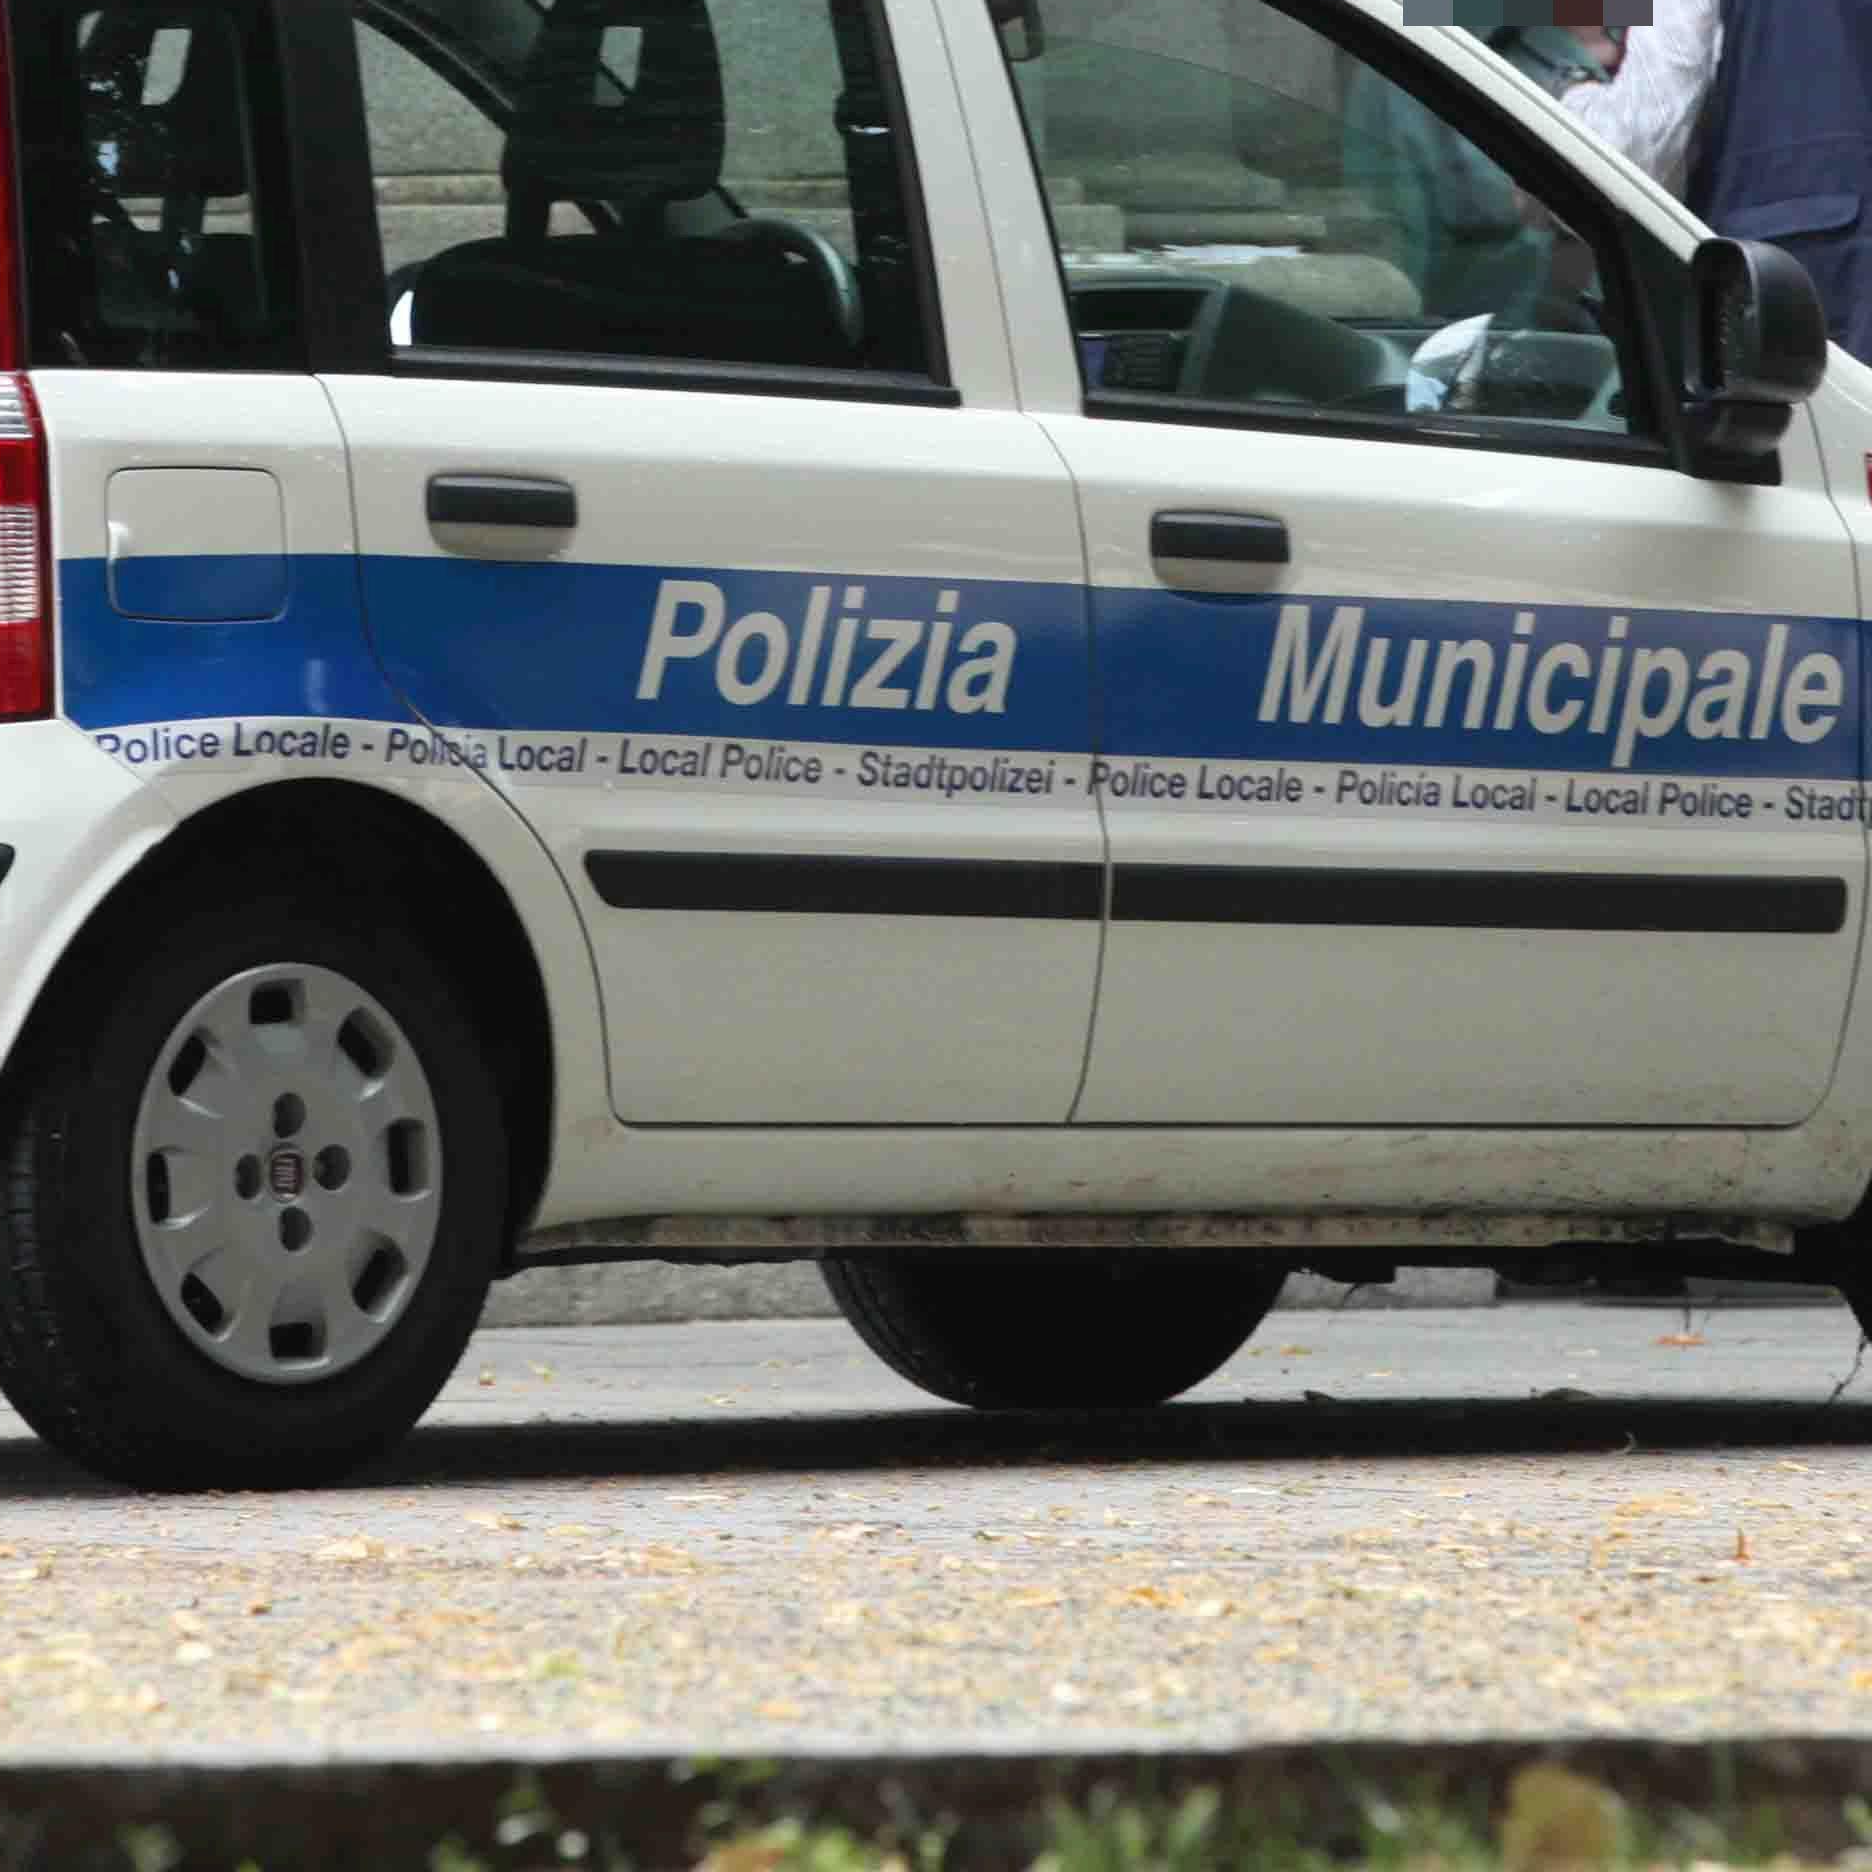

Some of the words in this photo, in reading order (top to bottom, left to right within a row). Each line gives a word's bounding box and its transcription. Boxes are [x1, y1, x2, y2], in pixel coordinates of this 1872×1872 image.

[635, 578, 1018, 715] Polizia
[1257, 603, 1845, 770] Municipale
[95, 728, 220, 764] Police
[233, 722, 350, 759] Locale
[498, 735, 588, 772] Local
[618, 737, 712, 778] Local
[720, 743, 823, 784] Police
[857, 750, 1056, 799] Stadtpolizei
[1087, 761, 1187, 798] Police
[1197, 764, 1304, 803] Locale
[1451, 774, 1538, 811] Local
[1566, 779, 1650, 814] Local
[1658, 782, 1753, 818] Police
